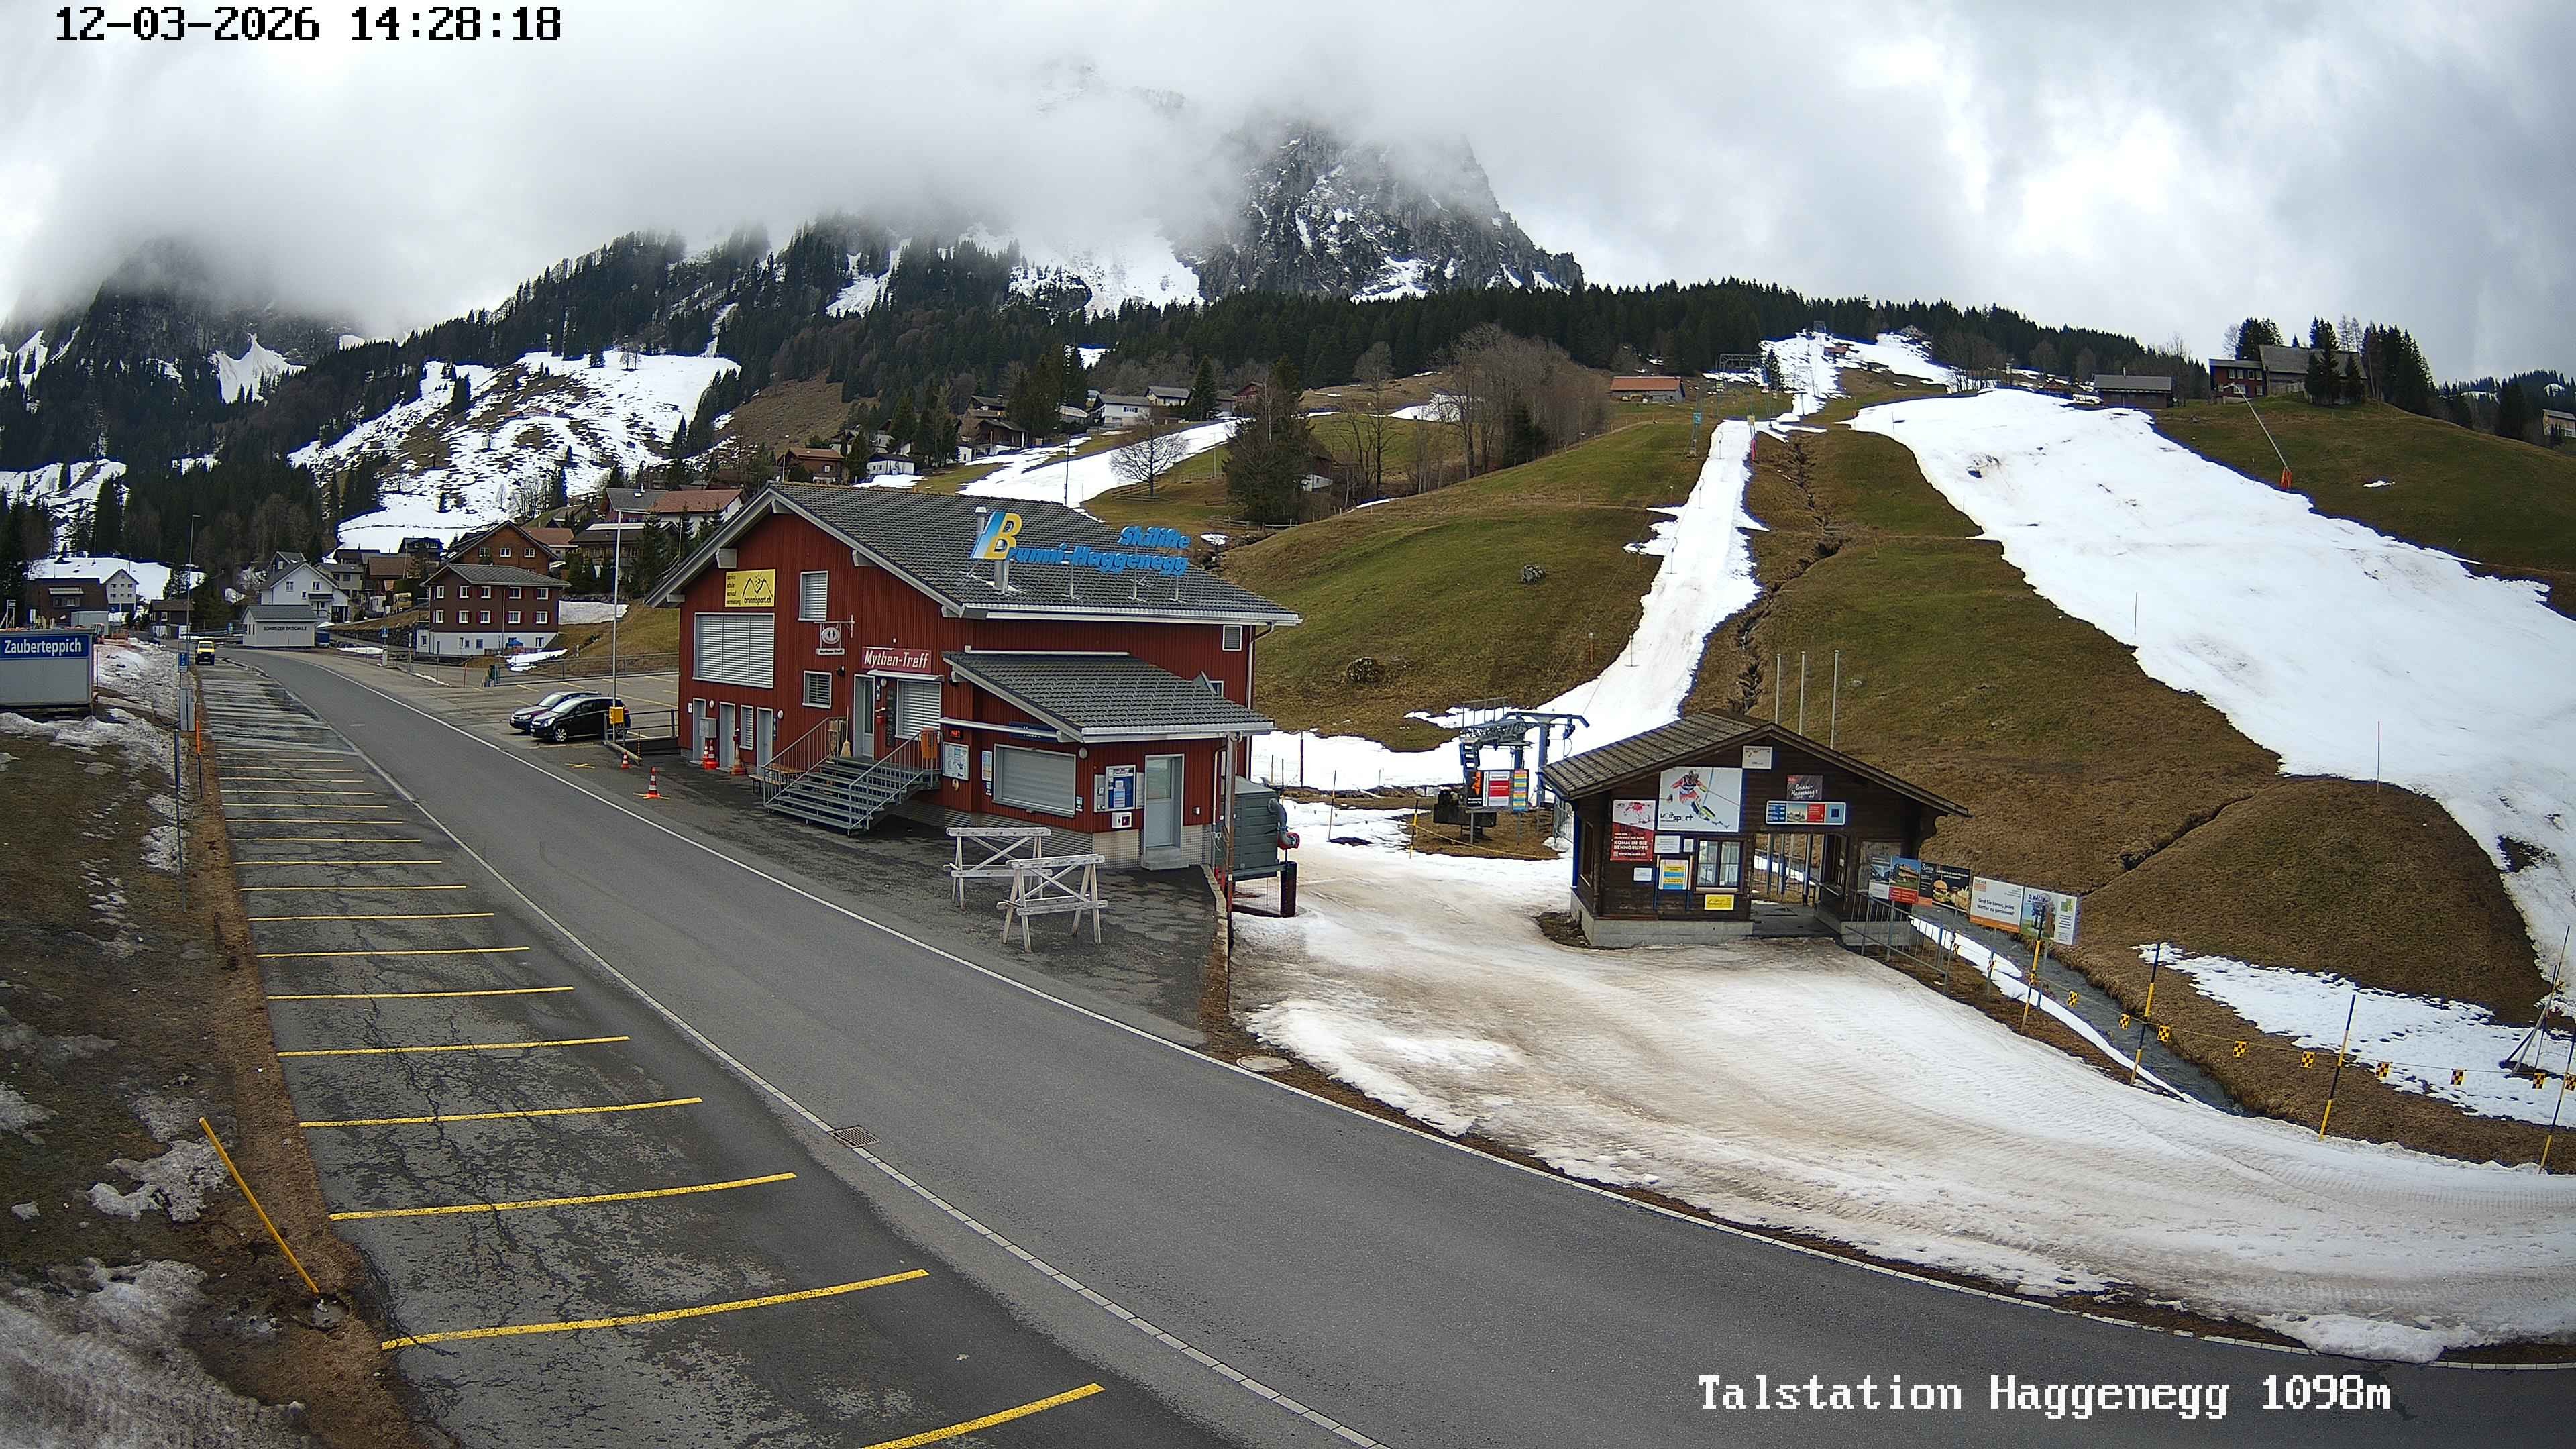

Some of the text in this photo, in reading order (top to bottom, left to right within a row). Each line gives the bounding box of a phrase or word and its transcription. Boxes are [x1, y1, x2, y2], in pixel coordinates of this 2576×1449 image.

[1118, 526, 1191, 549] Skilifte
[4, 637, 82, 657] Zauberteppich
[864, 649, 929, 669] Mythen-Treff
